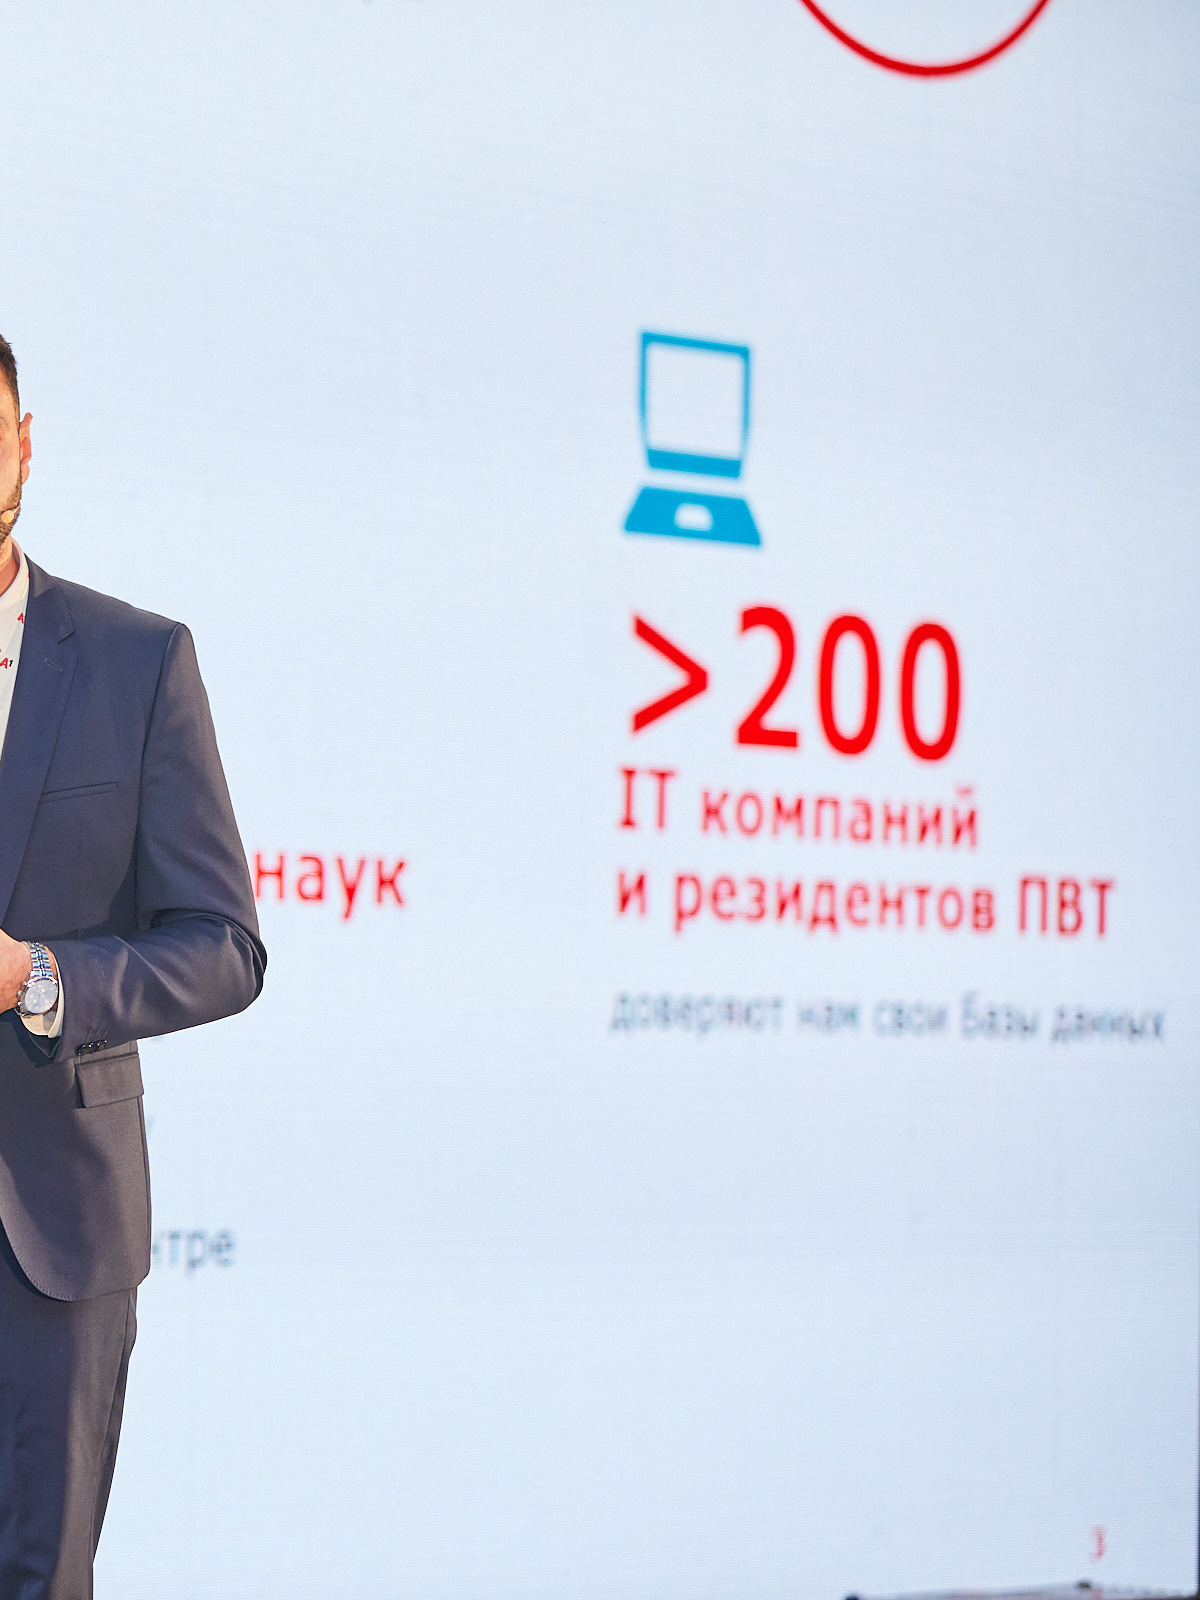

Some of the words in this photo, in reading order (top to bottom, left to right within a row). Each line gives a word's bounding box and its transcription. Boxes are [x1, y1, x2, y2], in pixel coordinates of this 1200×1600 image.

[734, 604, 963, 763] 200
[617, 766, 678, 831] IT
[699, 784, 979, 849] компаний
[255, 852, 406, 920] наук
[616, 871, 648, 918] и
[672, 871, 997, 937] резидентов
[1017, 873, 1118, 938] ПВТ
